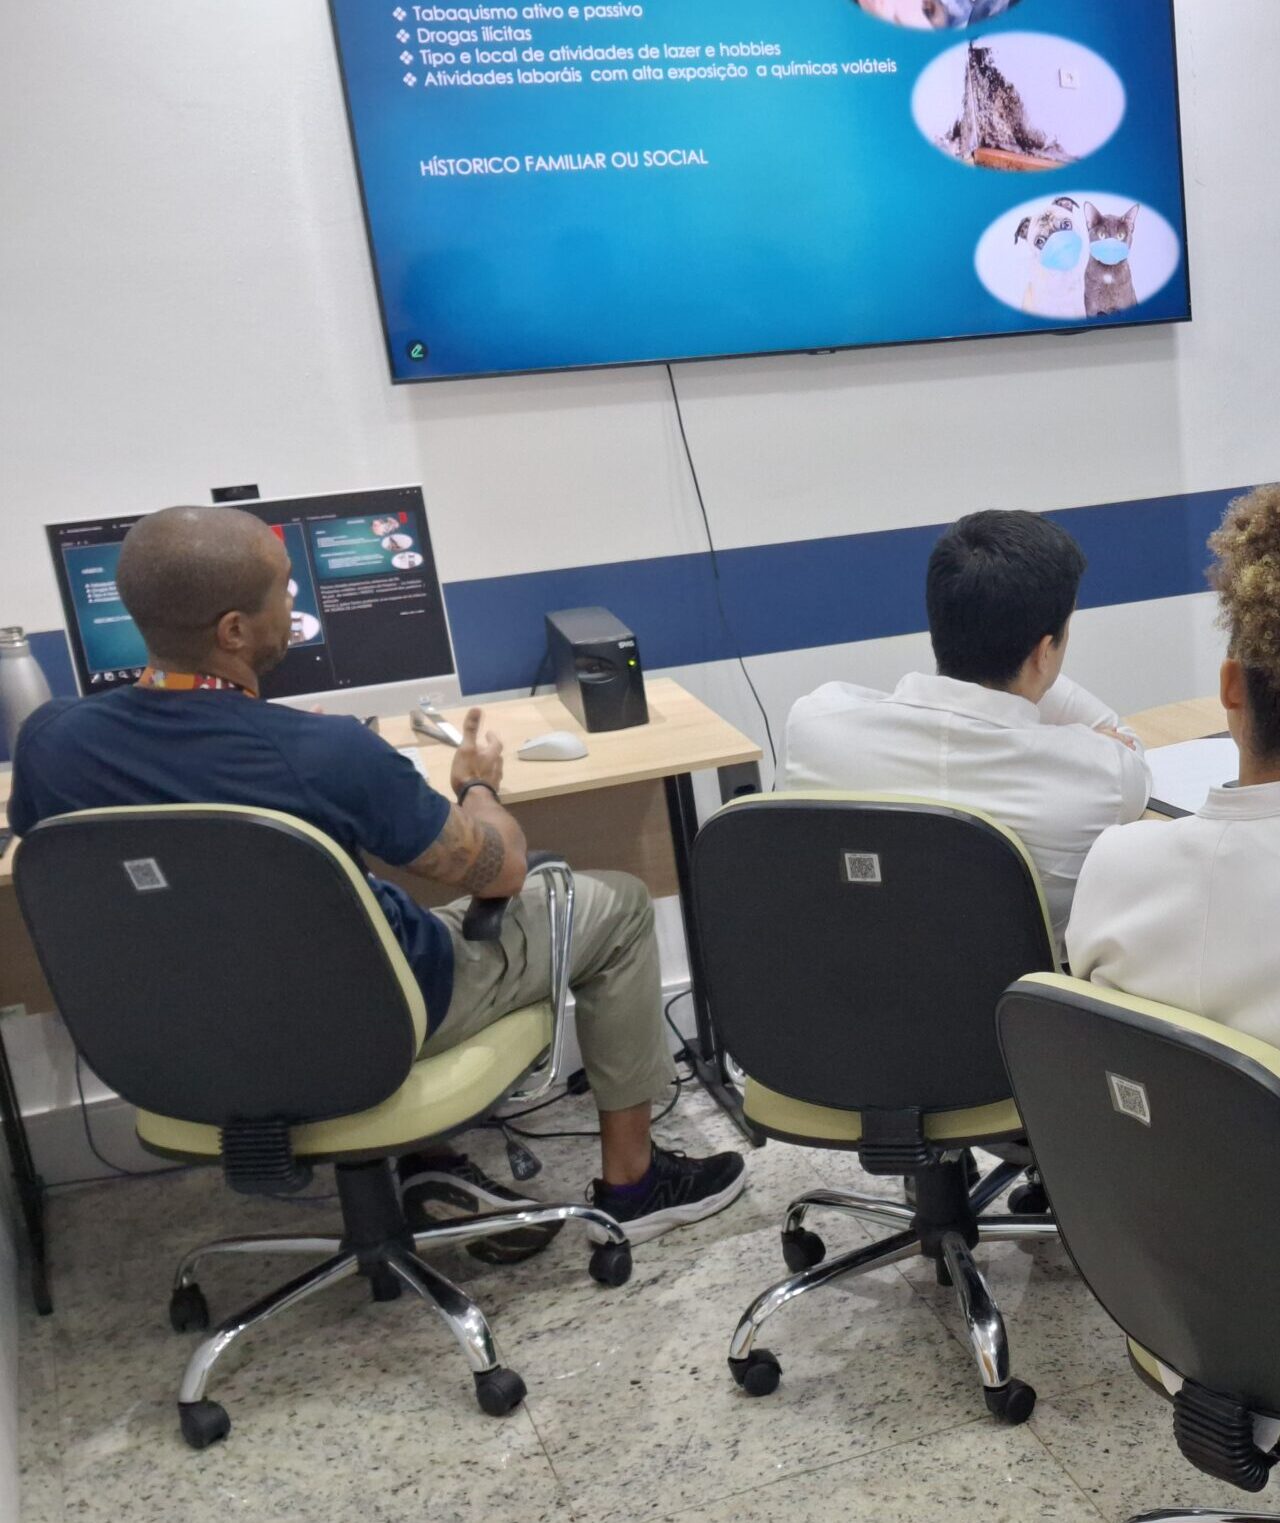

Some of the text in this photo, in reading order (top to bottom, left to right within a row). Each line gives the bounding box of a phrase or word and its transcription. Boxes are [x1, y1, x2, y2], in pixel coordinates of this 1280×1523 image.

[413, 1, 643, 23] Tabaquismo ativo e passivo
[417, 26, 532, 46] Drogas ilícitas
[420, 40, 781, 67] Tipo e local de atividades de lazer e hobbies
[425, 58, 897, 87] Atividades laboráis com alta exposição a químicos voláteis
[420, 149, 709, 176] HÍSTORICO FAMILIAR OU SOCIAL
